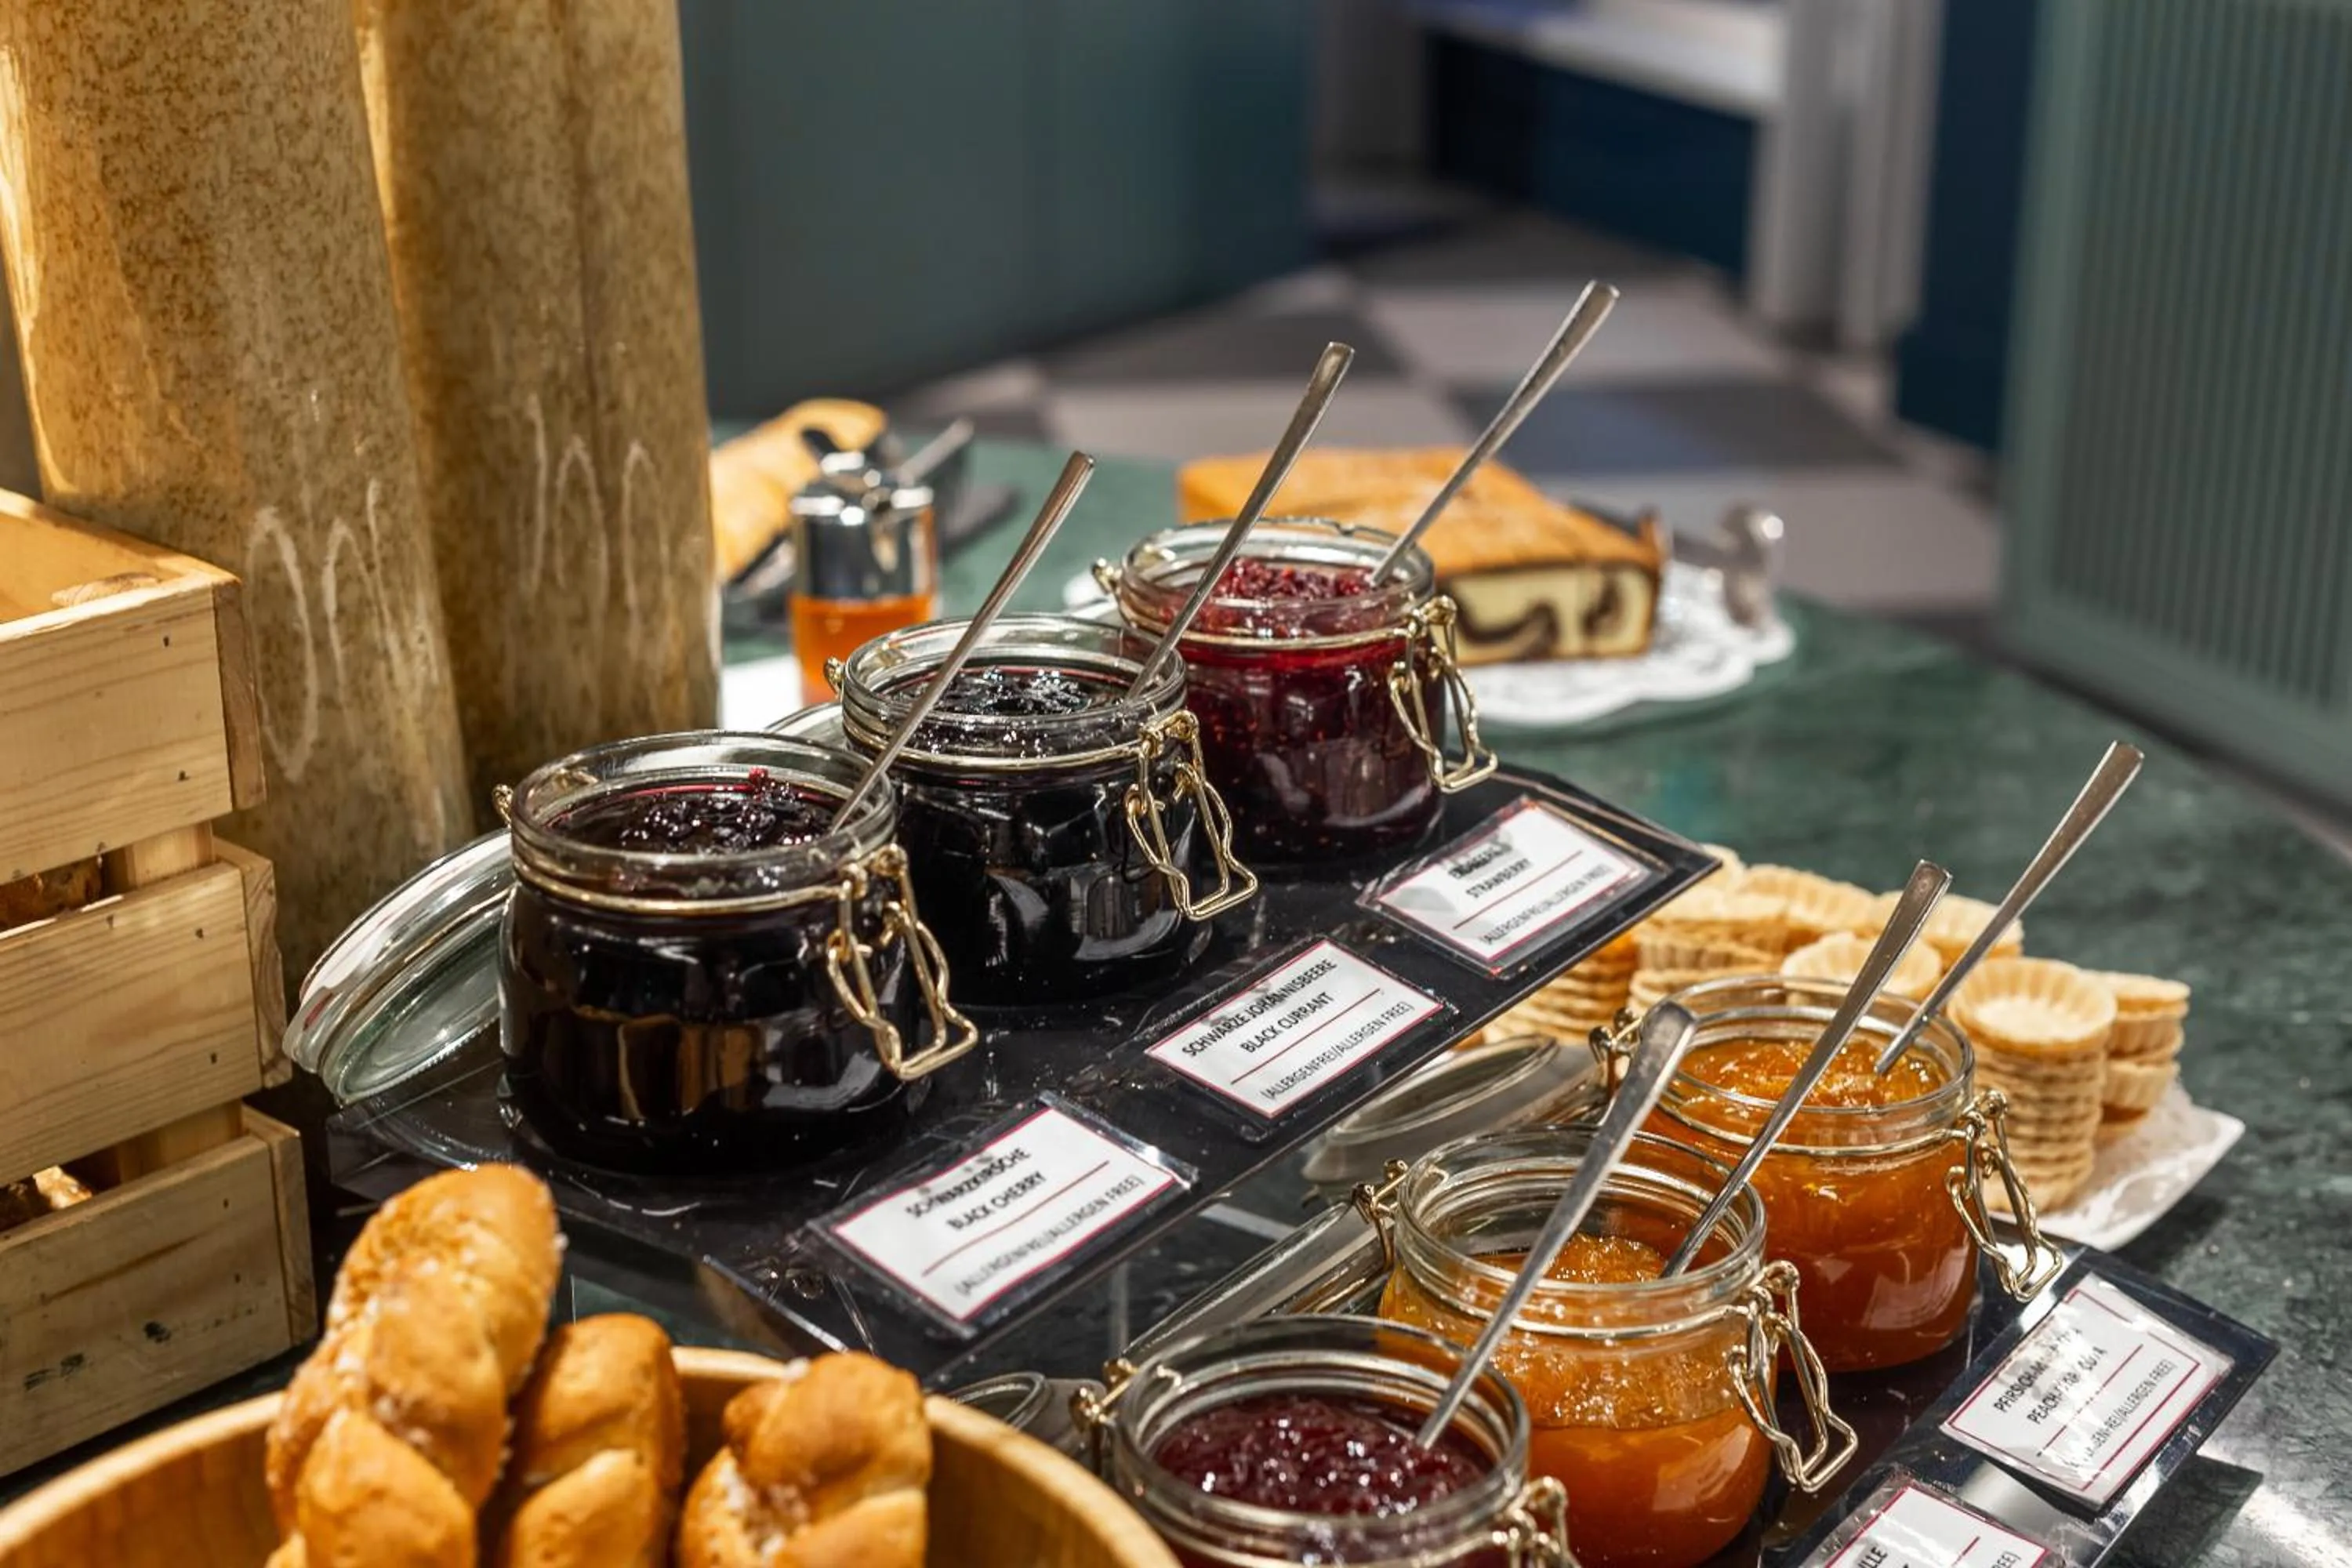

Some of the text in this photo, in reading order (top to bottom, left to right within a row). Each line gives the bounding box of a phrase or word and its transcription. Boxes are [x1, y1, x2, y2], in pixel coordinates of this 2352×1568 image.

[1181, 959, 1338, 1057] SCHWARZE JOHANNISBEERE
[1240, 991, 1334, 1054] BLACK CURRANT
[1381, 1000, 1415, 1023] FREE)
[946, 1171, 1047, 1230] BLACK CHERRY
